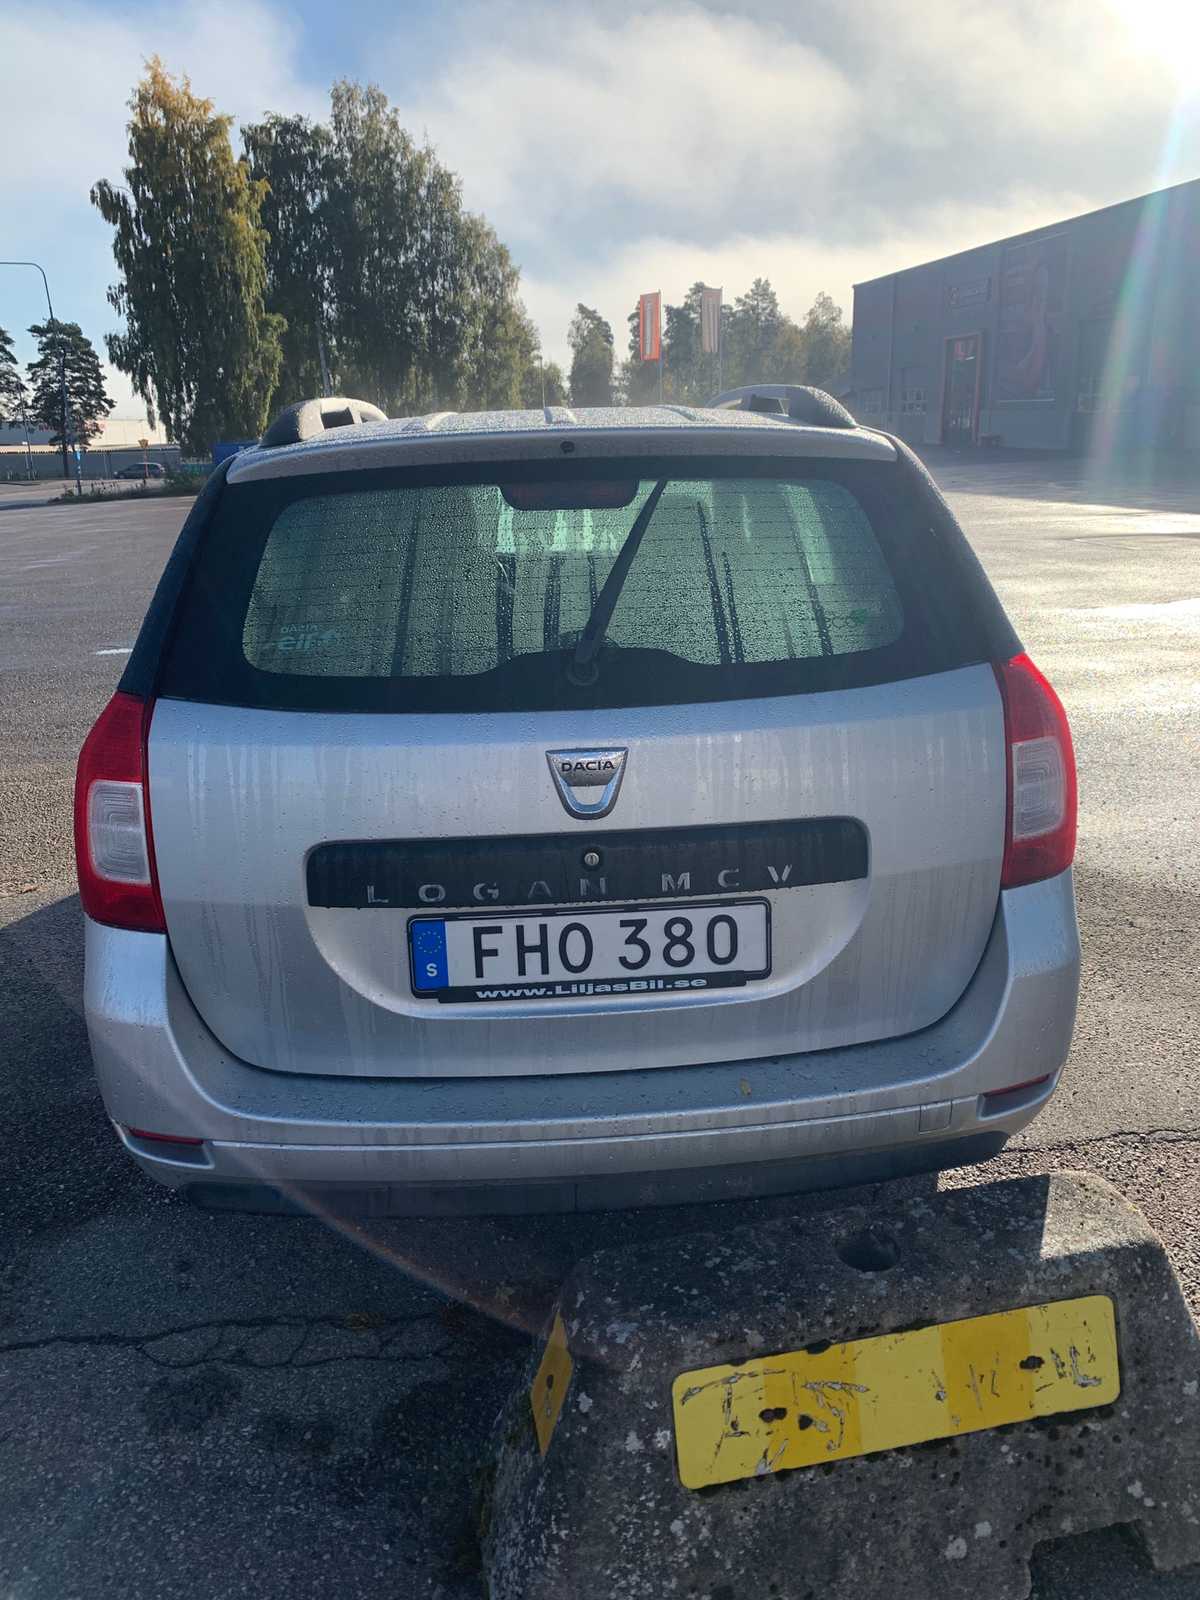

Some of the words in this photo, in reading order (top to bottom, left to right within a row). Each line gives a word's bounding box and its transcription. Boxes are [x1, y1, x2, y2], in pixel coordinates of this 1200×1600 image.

[561, 760, 615, 772] DACIA
[366, 877, 607, 903] LOGAN
[661, 864, 793, 892] MCV
[472, 922, 594, 979] FHO
[618, 914, 738, 971] 380
[426, 963, 438, 977] S
[475, 978, 708, 999] www.LiljasBil.se
